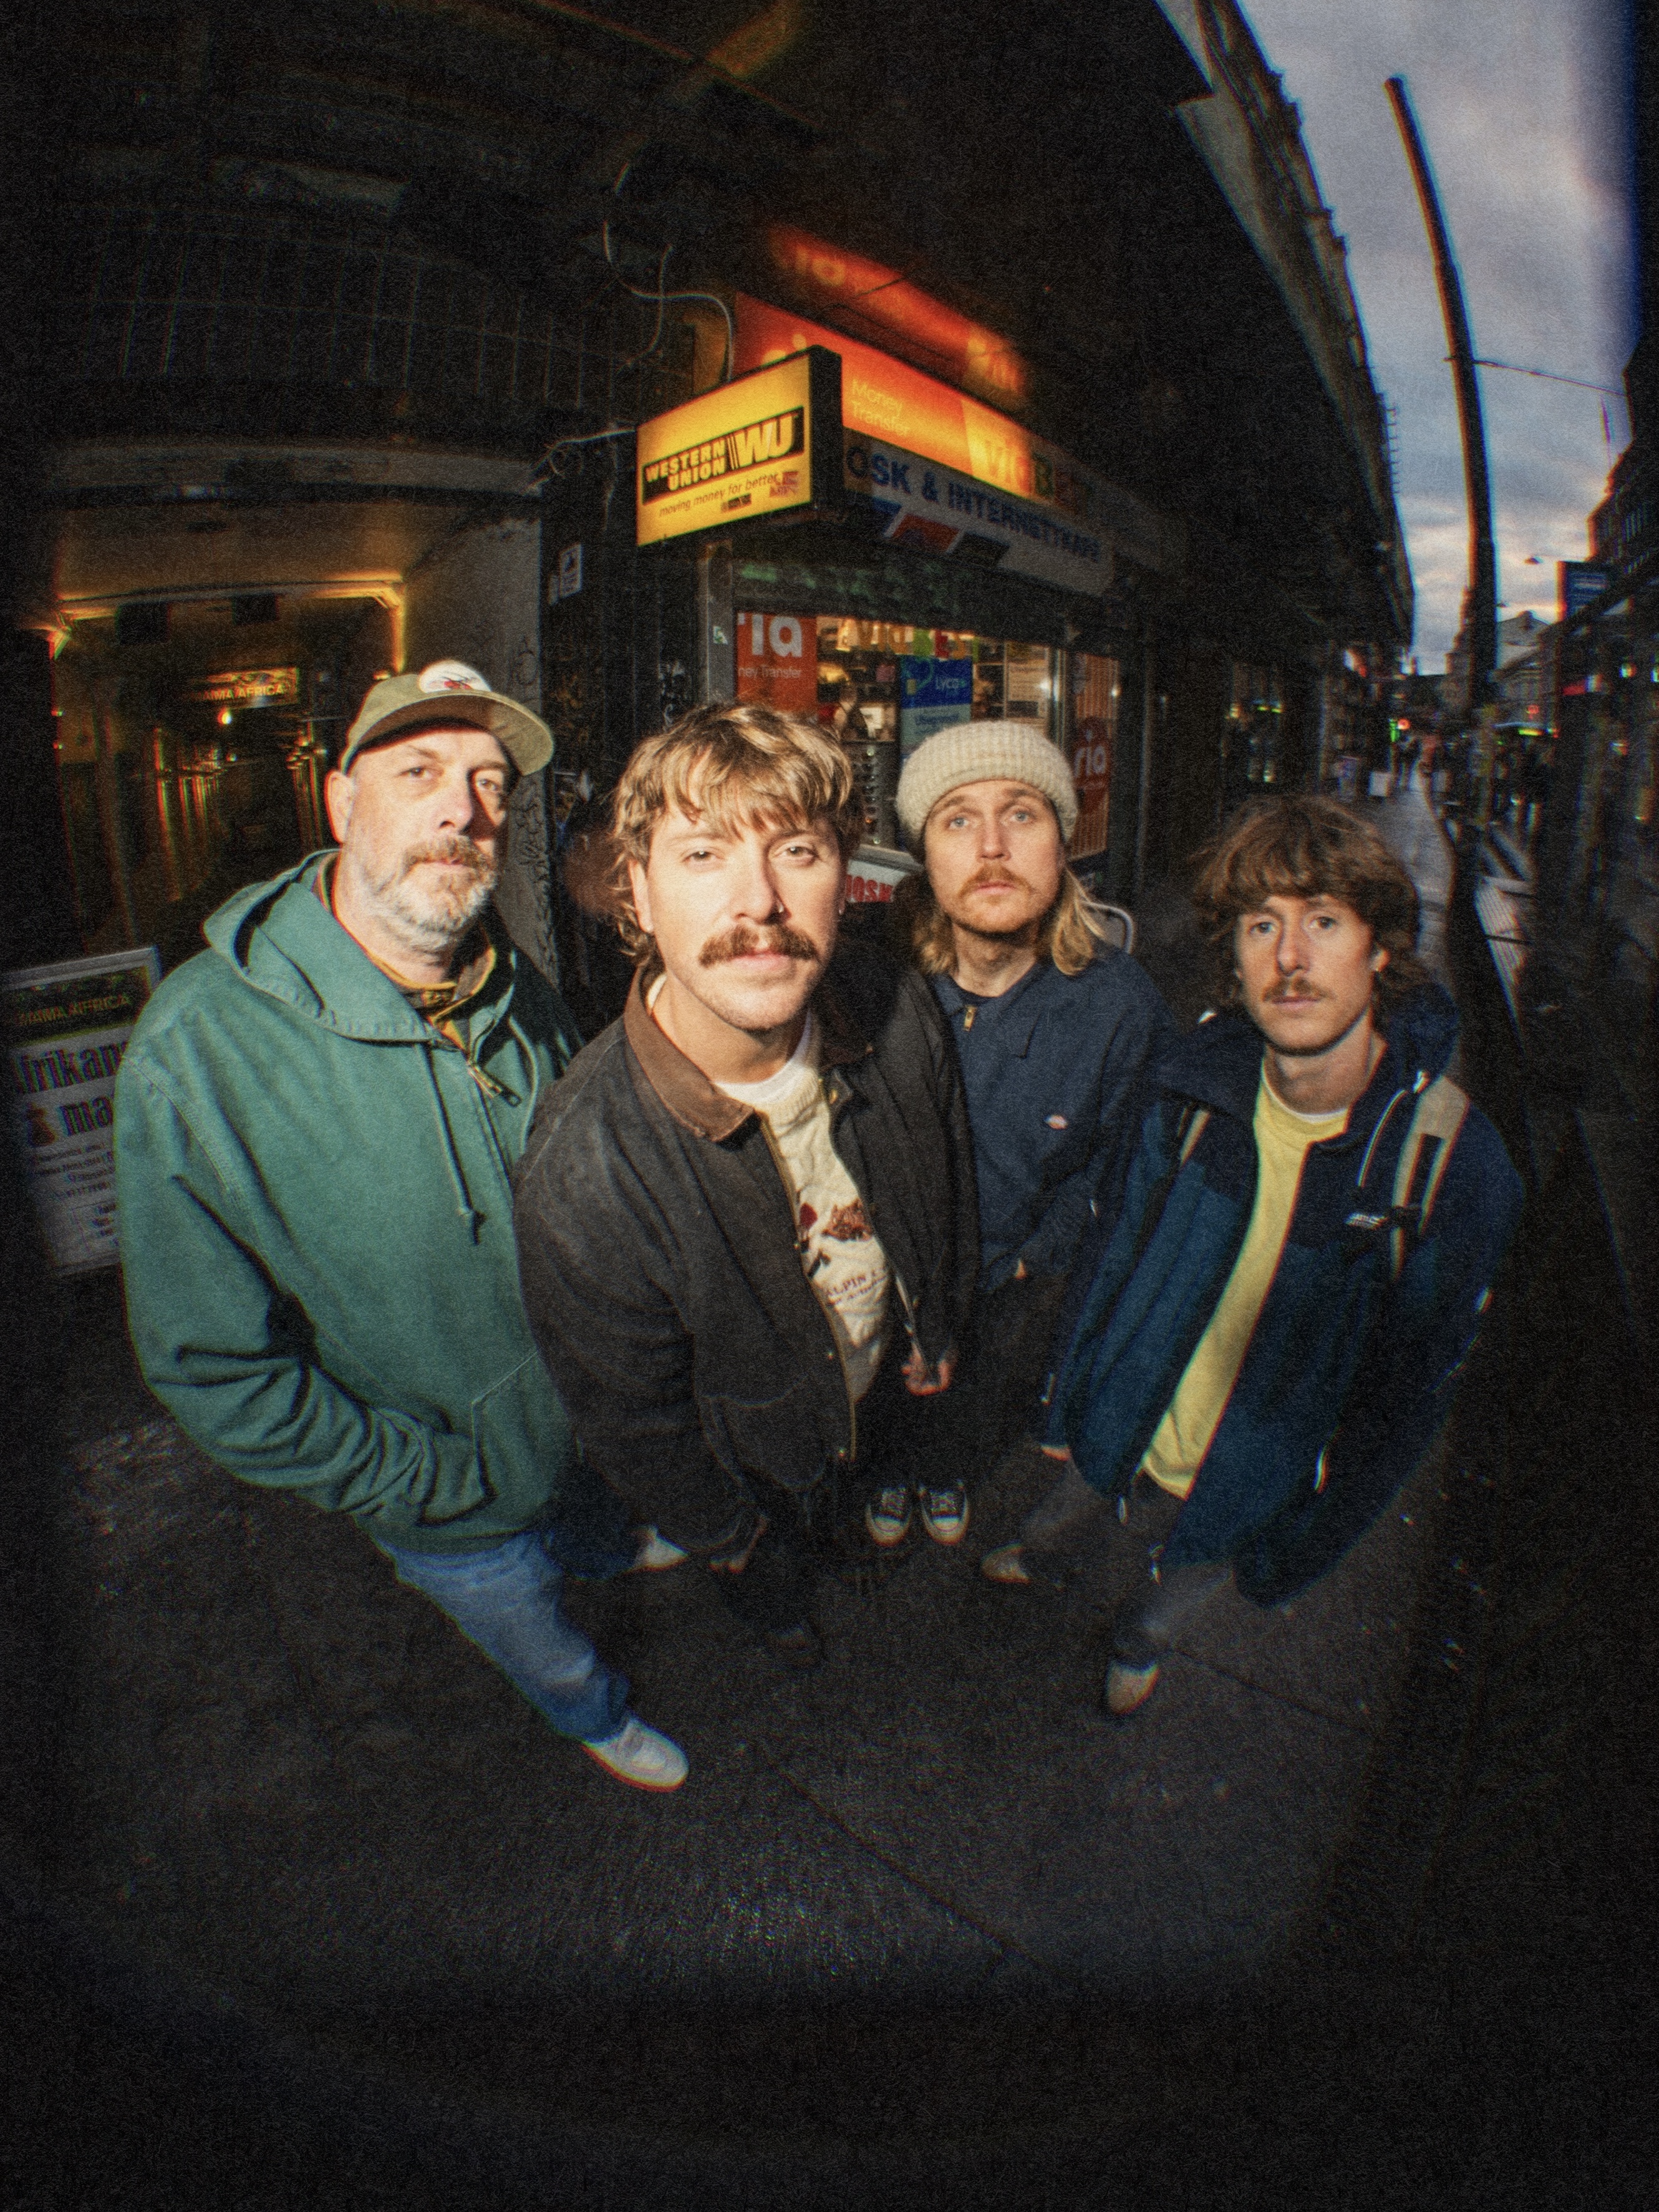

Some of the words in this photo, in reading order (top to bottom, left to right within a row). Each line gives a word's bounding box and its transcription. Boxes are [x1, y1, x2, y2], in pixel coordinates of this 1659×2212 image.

[851, 379, 903, 419] Money
[850, 400, 911, 438] Transfer
[734, 412, 795, 468] WU
[645, 438, 727, 483] WESTERN
[668, 456, 726, 491] UNION
[659, 500, 692, 517] moving
[693, 489, 726, 507] money
[728, 482, 743, 496] for
[922, 470, 940, 505] &
[236, 683, 285, 698] AFRICA
